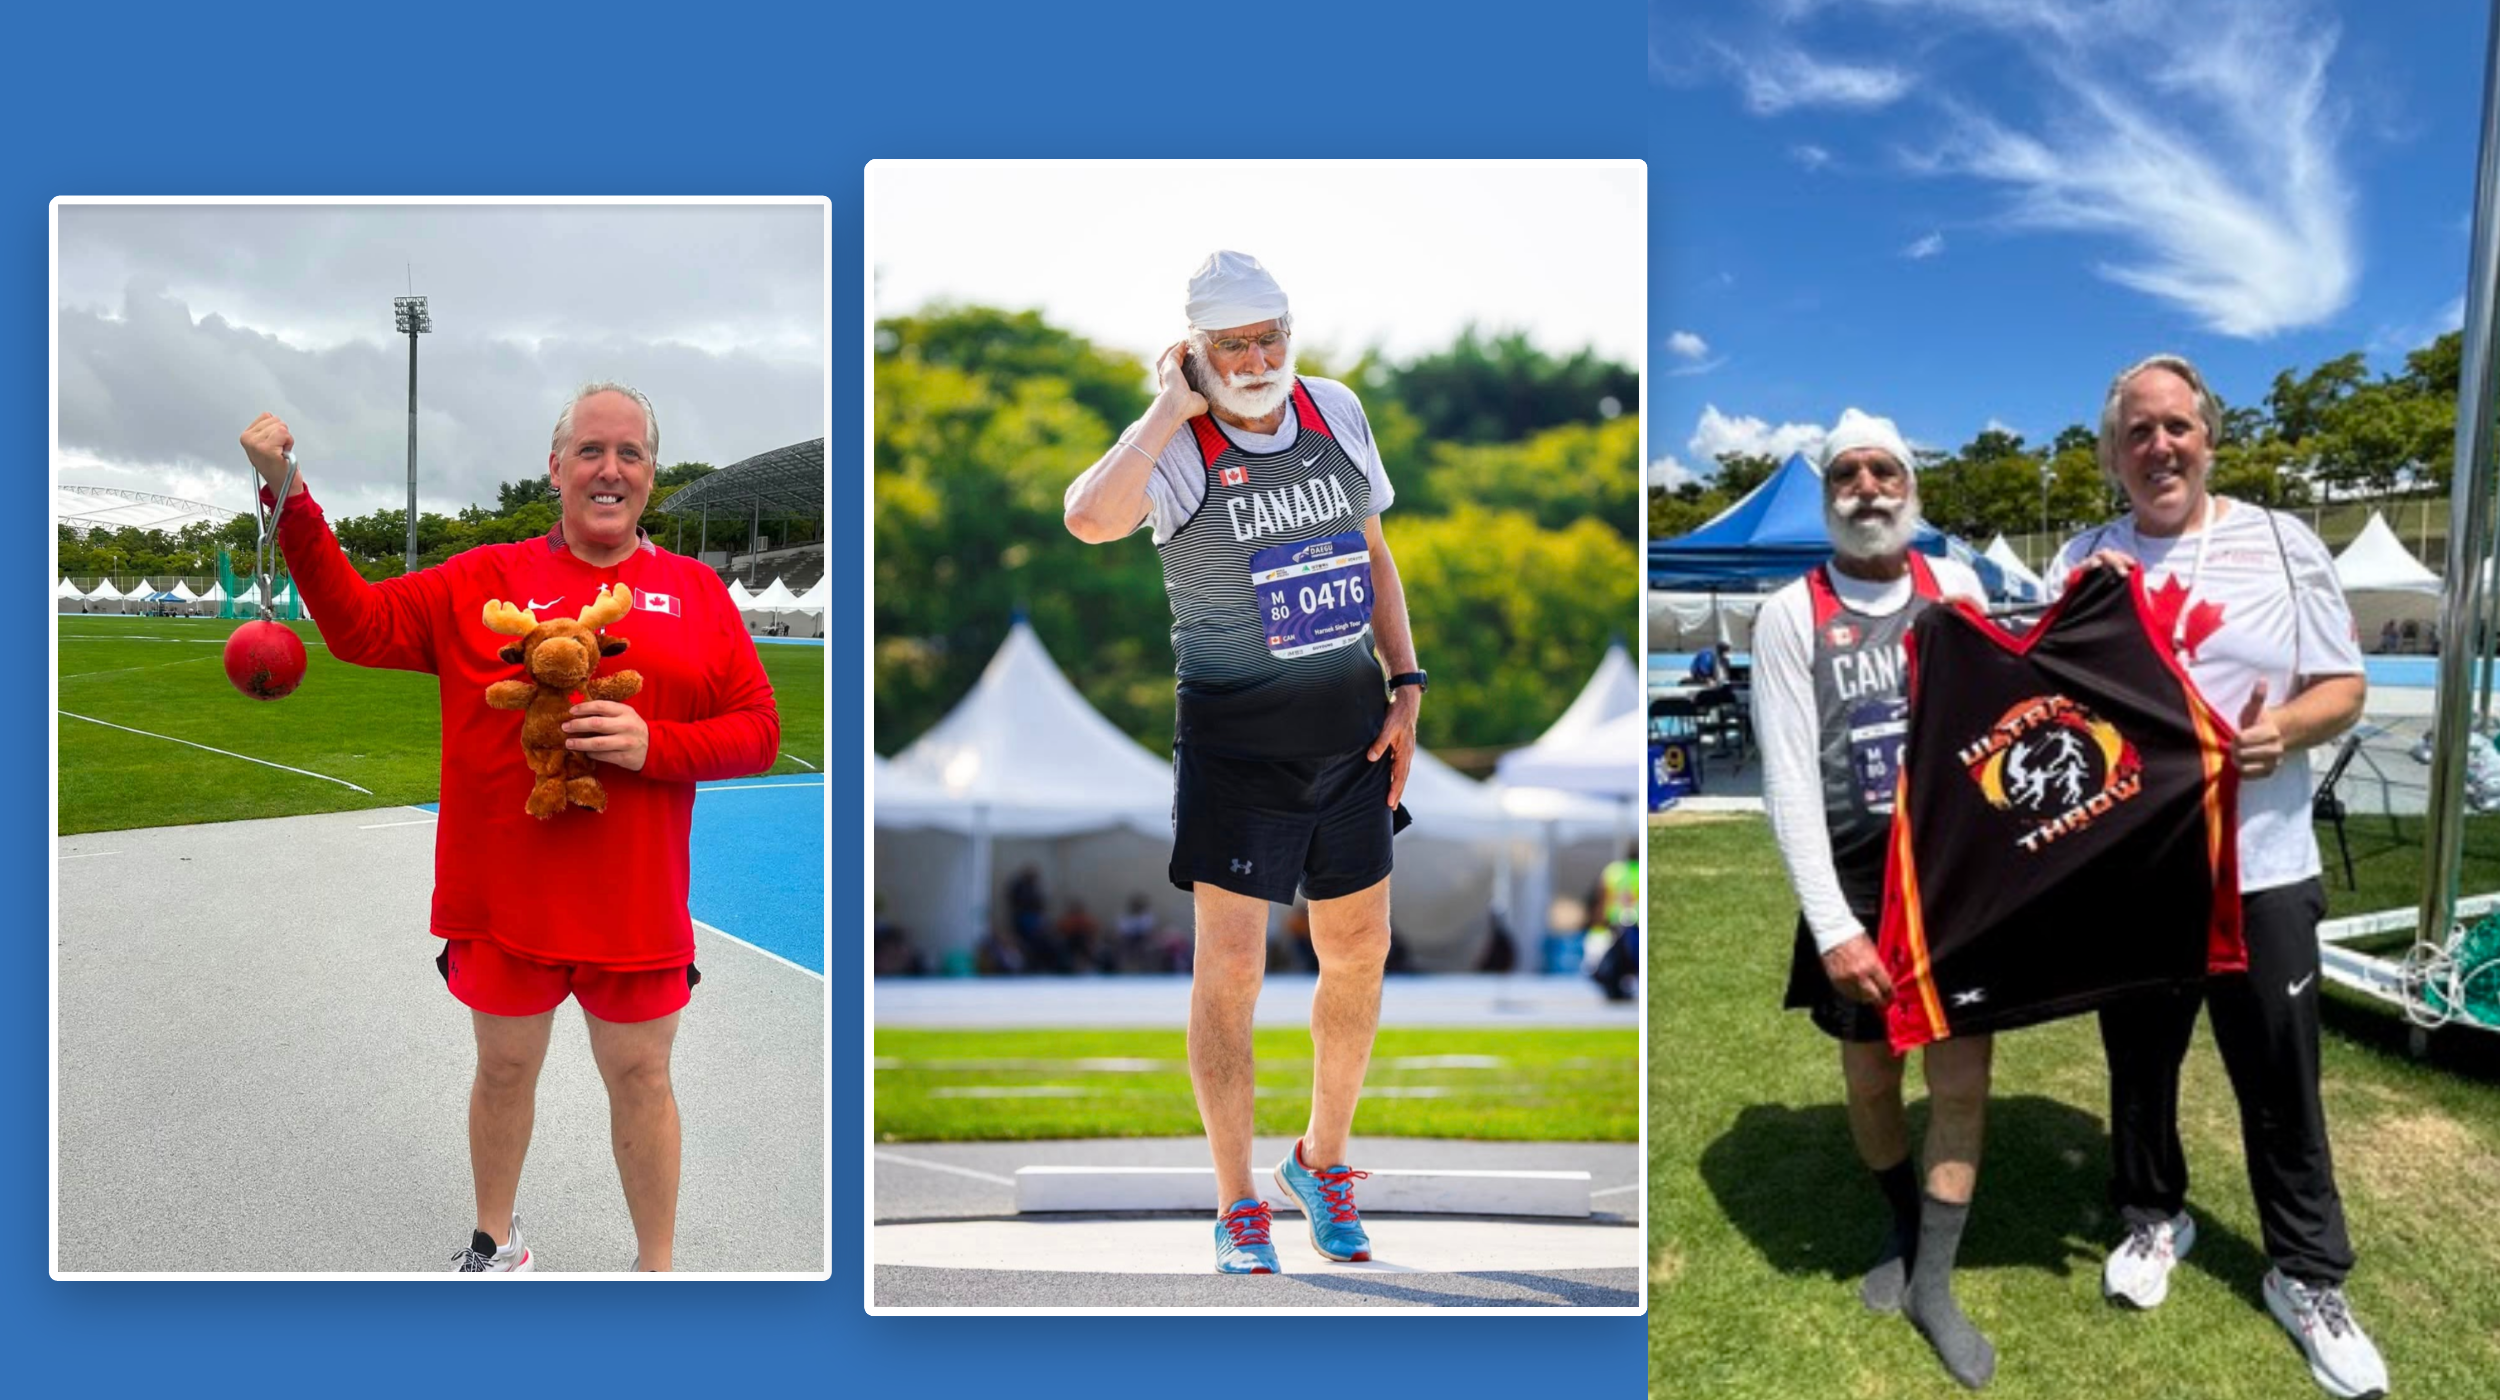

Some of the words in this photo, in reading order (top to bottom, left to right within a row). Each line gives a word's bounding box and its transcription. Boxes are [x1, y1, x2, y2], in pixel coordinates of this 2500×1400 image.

[1227, 474, 1352, 542] CANADA
[1310, 544, 1333, 555] DAEGU
[1271, 590, 1285, 604] M
[1299, 576, 1365, 615] 0476
[1271, 605, 1290, 621] 80
[1314, 625, 1334, 635] Harnek
[1334, 622, 1349, 631] Singh
[1349, 620, 1361, 628] Toor
[1283, 634, 1295, 642] CAN
[2016, 773, 2142, 851] THROW
